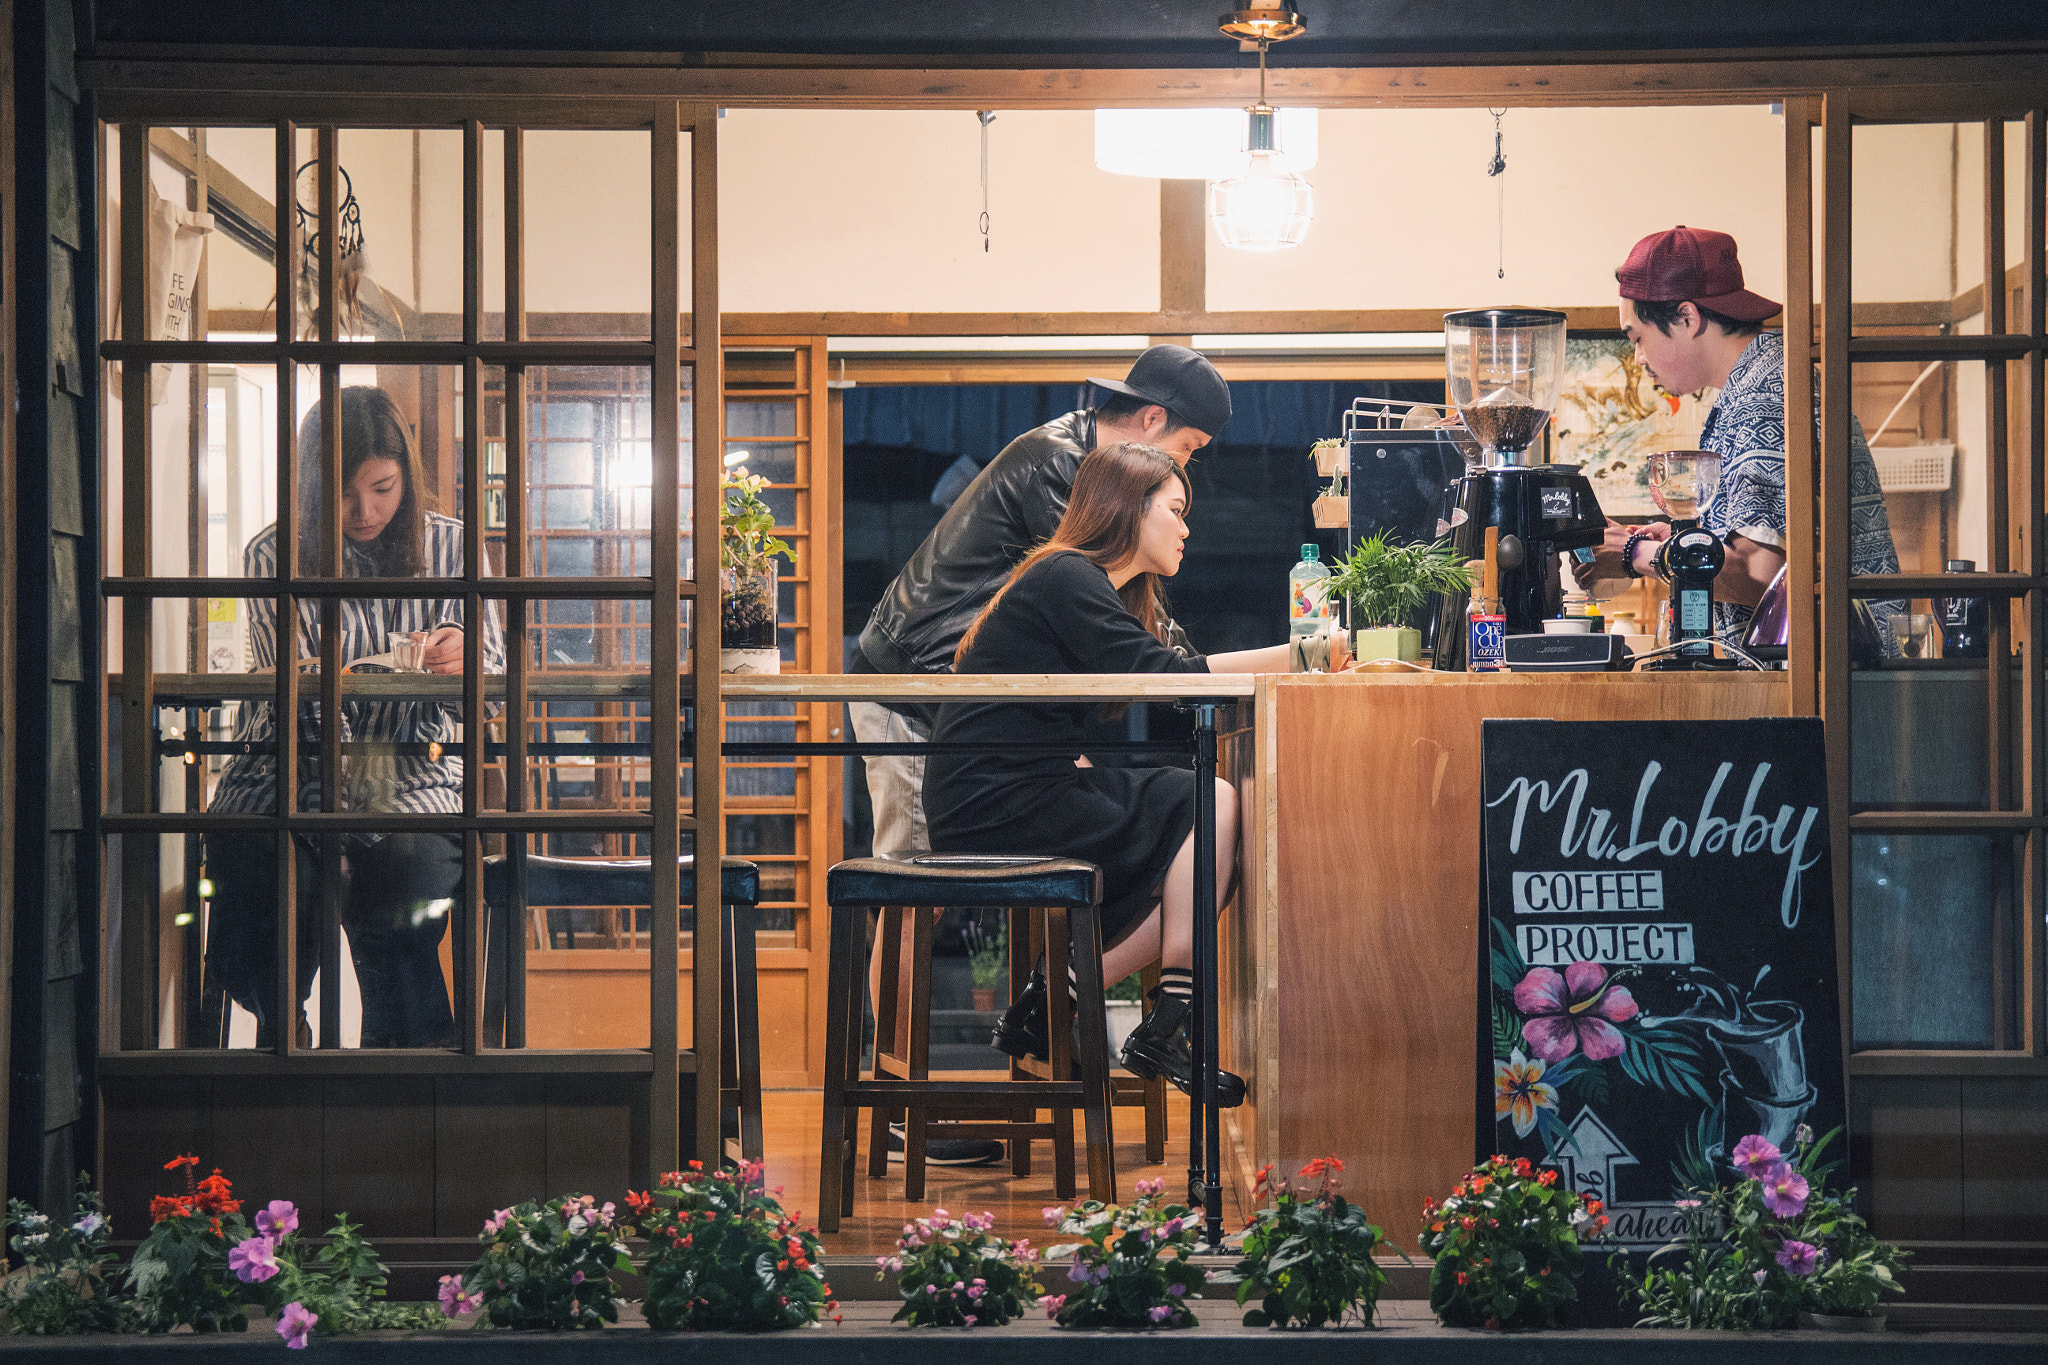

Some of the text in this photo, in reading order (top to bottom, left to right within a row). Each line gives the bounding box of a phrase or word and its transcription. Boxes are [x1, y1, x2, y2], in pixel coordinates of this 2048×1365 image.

[168, 293, 191, 312] GINS
[1475, 622, 1502, 635] One
[1523, 872, 1660, 911] COFFEE
[1526, 924, 1688, 963] PROJECT
